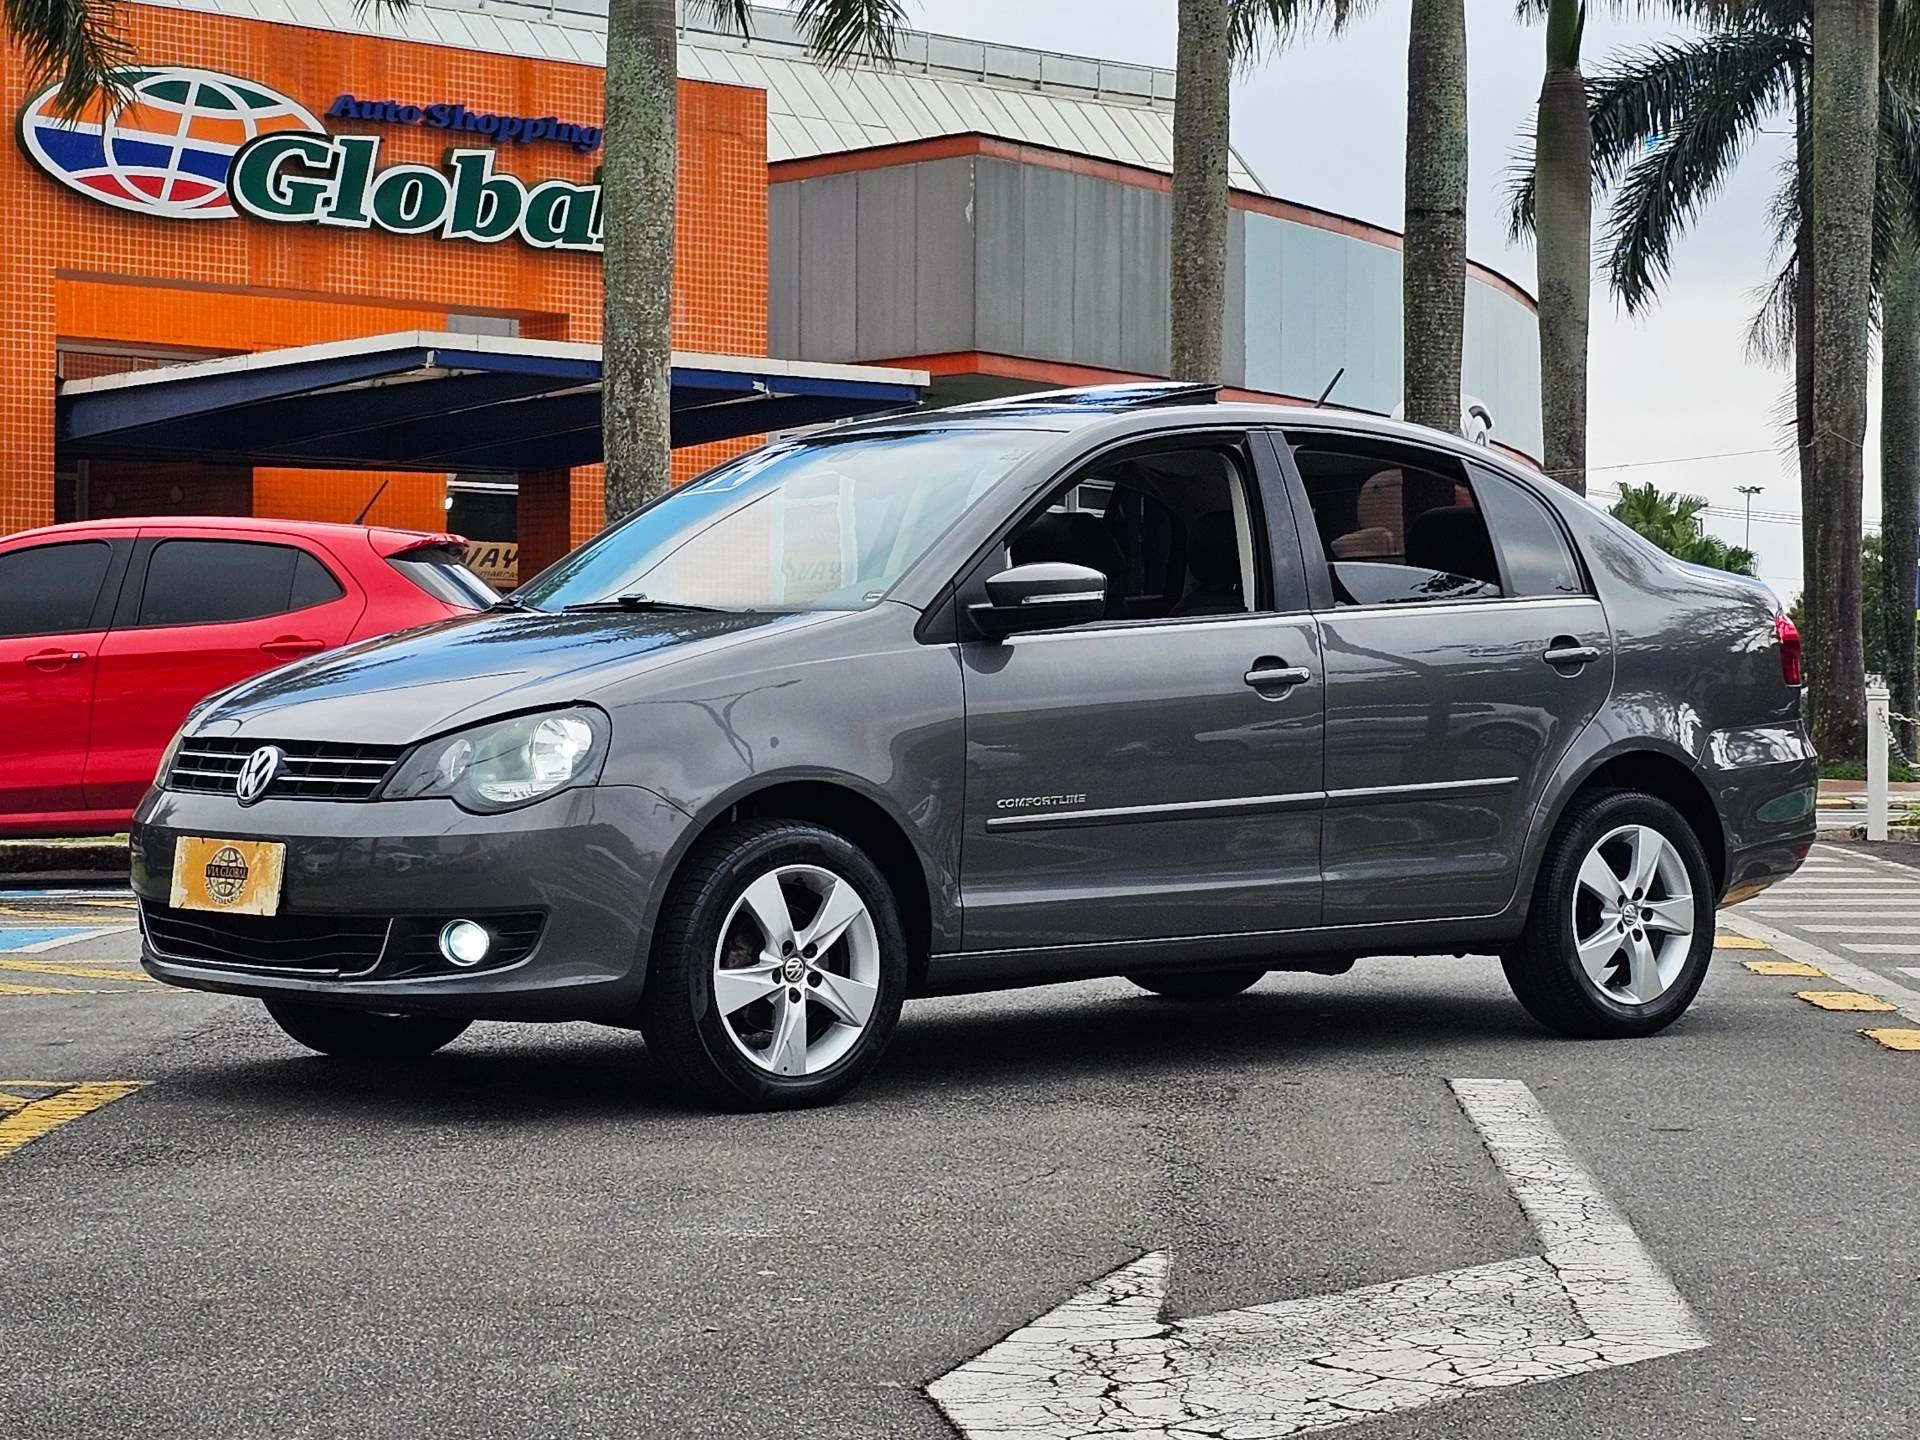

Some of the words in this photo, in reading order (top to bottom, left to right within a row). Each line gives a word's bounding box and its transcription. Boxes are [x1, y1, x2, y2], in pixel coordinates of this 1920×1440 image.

[325, 95, 421, 124] Auto
[423, 103, 602, 150] Shopping
[233, 133, 604, 251] Globa
[996, 794, 1086, 809] COMFORTLINE
